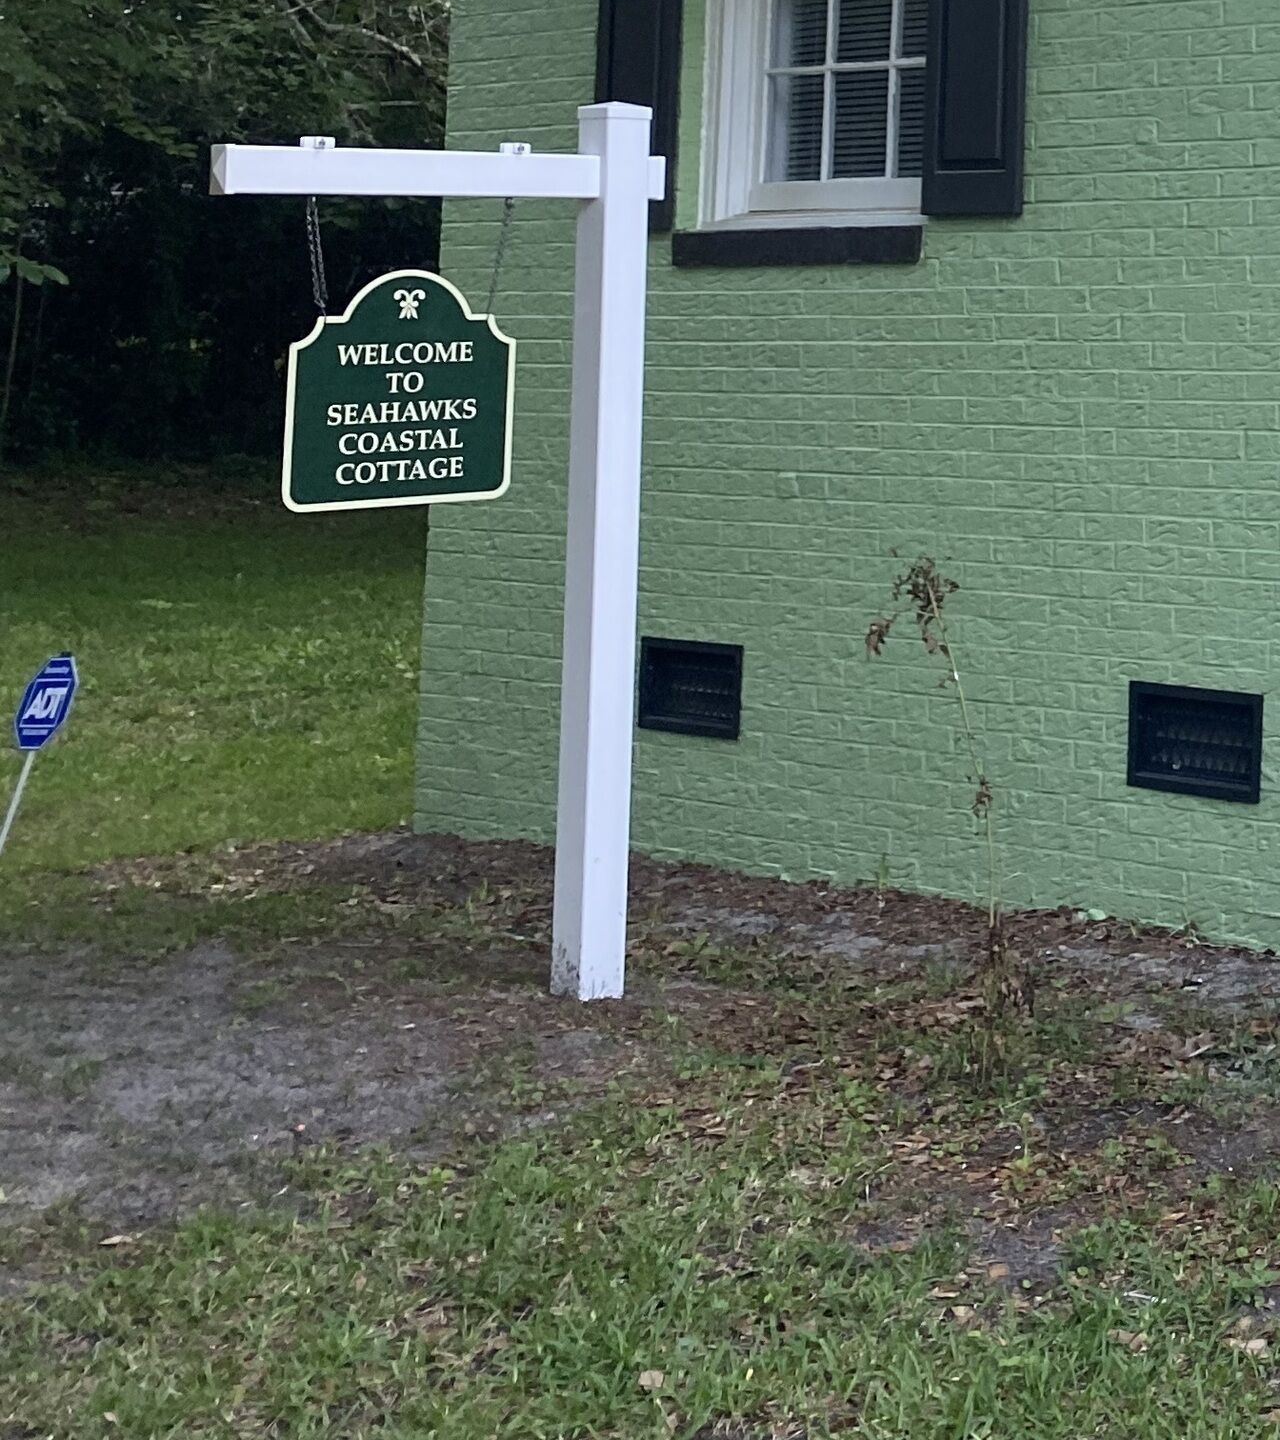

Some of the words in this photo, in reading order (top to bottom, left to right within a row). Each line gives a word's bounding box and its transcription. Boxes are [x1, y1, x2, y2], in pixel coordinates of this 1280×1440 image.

[337, 341, 474, 366] WELCOME
[385, 371, 424, 393] TO
[326, 398, 477, 426] SEAHAWKS
[338, 428, 463, 455] COASTAL
[335, 456, 464, 485] COTTAGE
[22, 686, 69, 720] ADT
